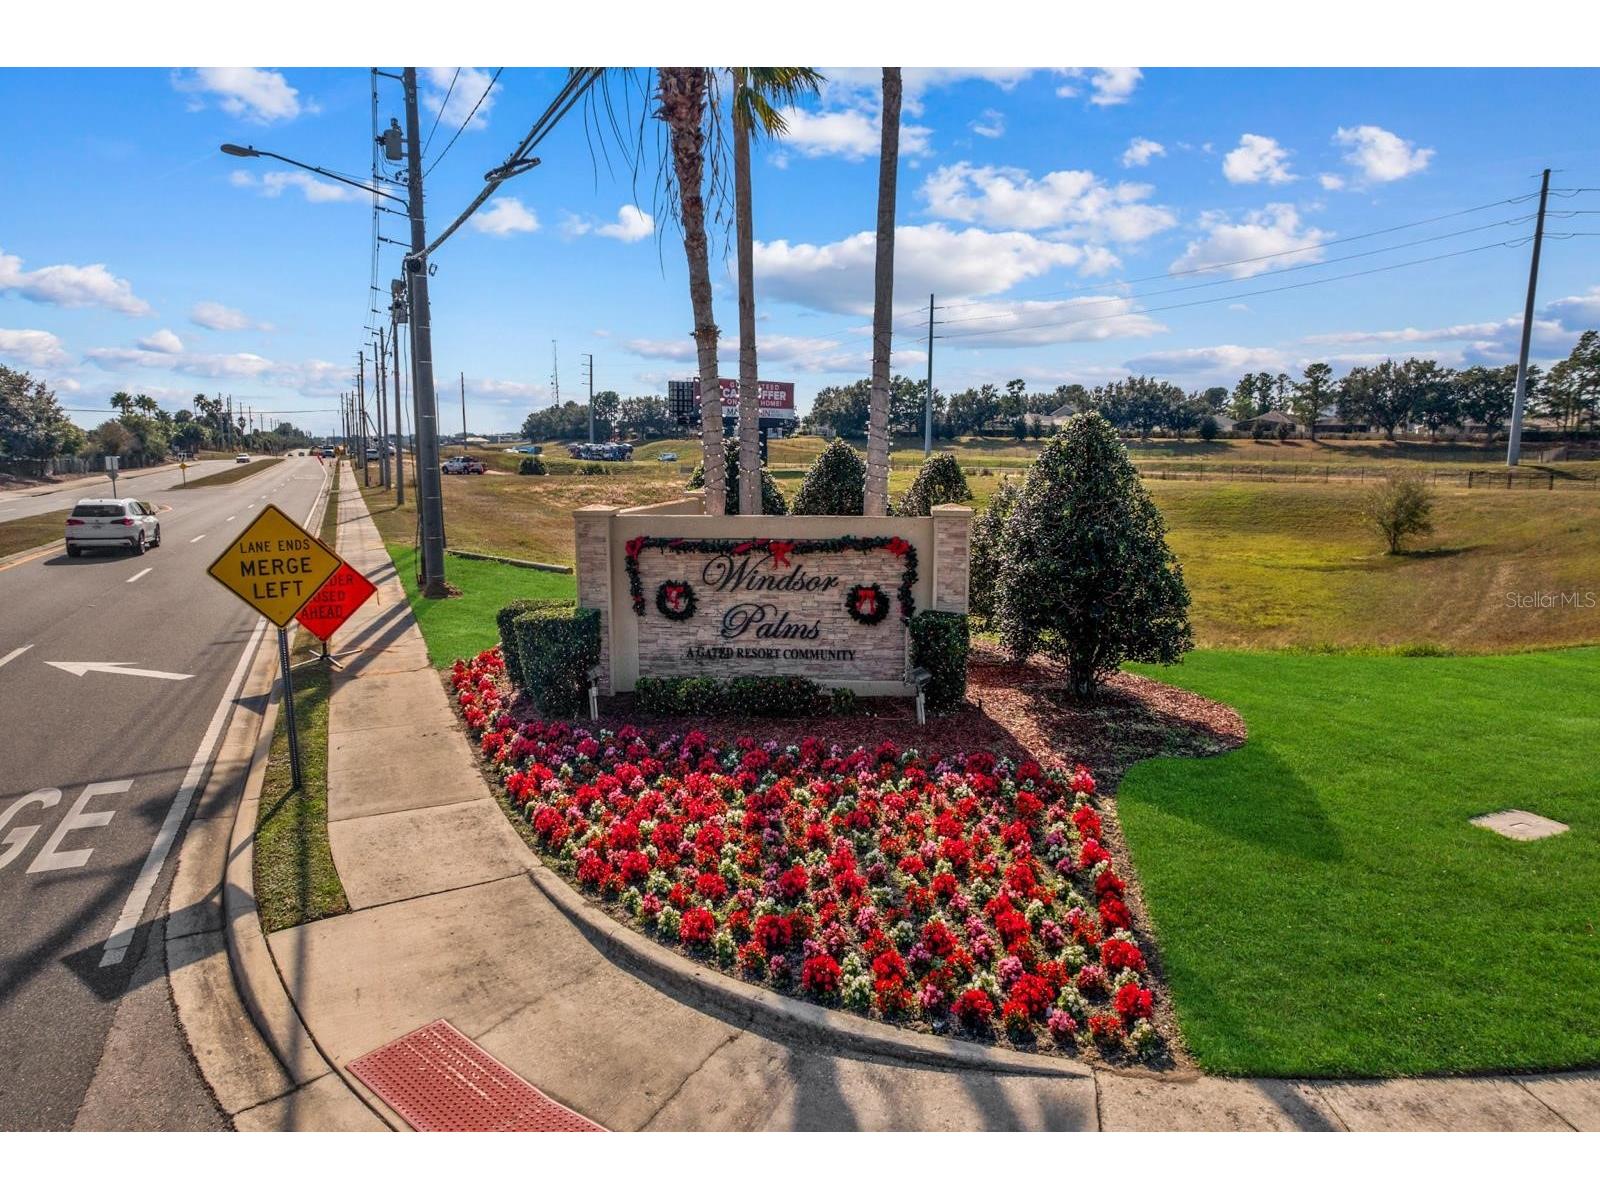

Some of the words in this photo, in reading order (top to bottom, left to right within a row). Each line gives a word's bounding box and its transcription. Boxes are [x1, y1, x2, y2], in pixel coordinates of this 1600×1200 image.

[239, 541, 271, 554] LANE
[278, 539, 310, 551] ENDS
[240, 557, 313, 577] MERGE
[702, 553, 839, 592] Windsor
[253, 580, 303, 599] LEFT
[302, 605, 343, 619] AHEAD
[720, 603, 821, 640] Palms
[697, 647, 734, 660] GATED
[736, 648, 781, 660] RESORT
[783, 649, 857, 661] COMMUNITY
